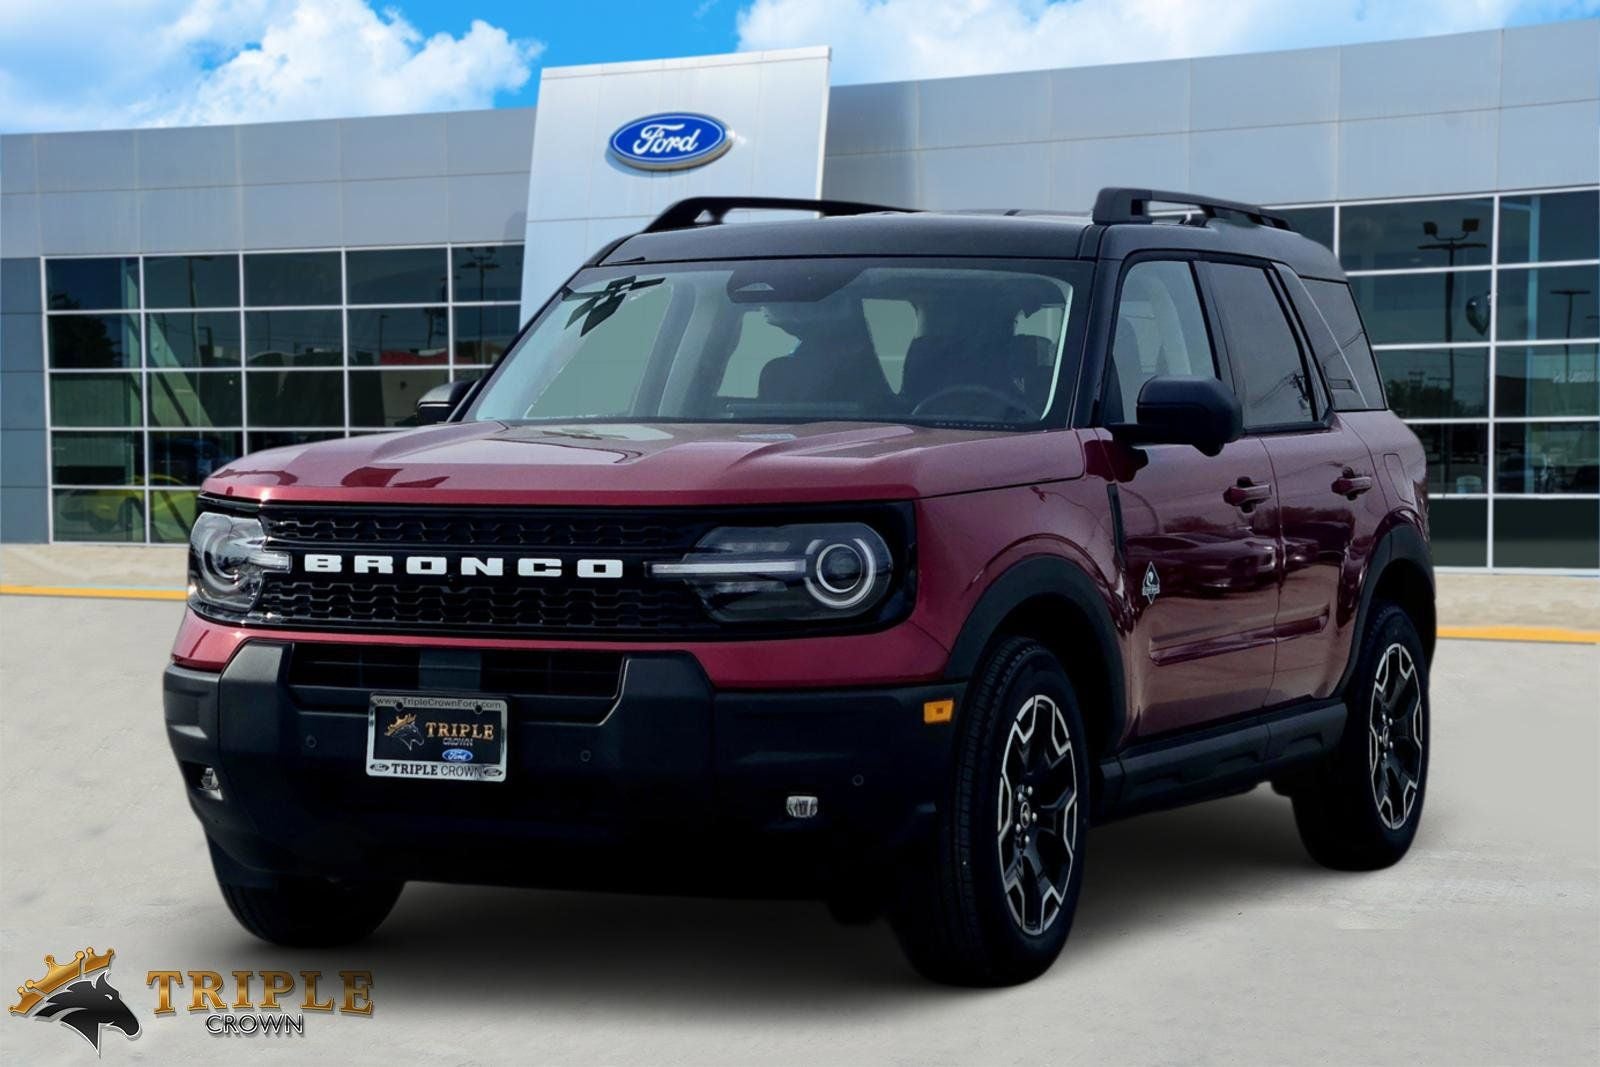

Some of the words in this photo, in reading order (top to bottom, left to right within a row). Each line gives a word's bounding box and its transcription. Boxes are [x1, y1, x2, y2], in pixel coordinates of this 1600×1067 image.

[633, 124, 701, 154] Ford
[304, 554, 623, 578] BRONCO
[425, 722, 494, 740] TRIPLE
[391, 763, 438, 775] TRIPLE
[440, 766, 484, 778] CROWN
